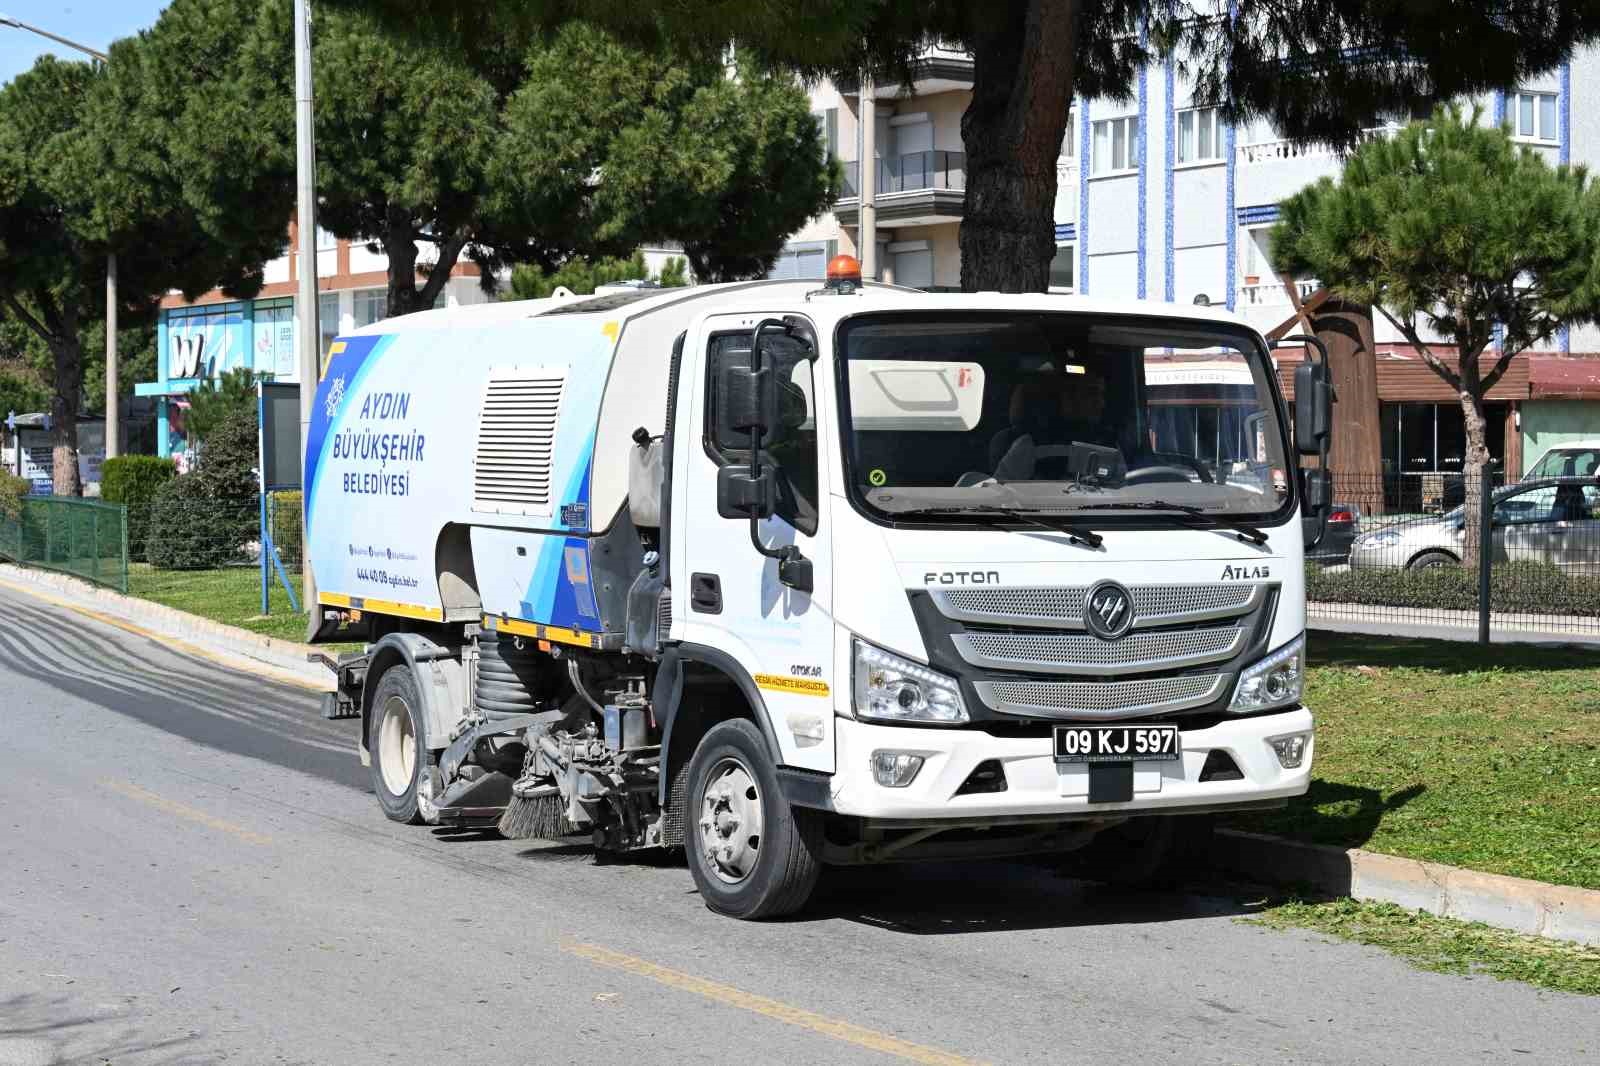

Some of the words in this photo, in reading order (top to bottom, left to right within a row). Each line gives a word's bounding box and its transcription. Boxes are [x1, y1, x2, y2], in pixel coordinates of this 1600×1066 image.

[360, 392, 411, 420] AYDIN
[333, 427, 425, 468] BÜYÜKŞEHİR
[343, 469, 410, 496] BELEDİYESİ
[357, 568, 369, 581] 444
[924, 571, 1000, 585] FOTON
[1220, 565, 1271, 581] ATLAS
[790, 664, 822, 677] OTOKAR
[1065, 730, 1093, 754] 09
[1098, 730, 1130, 754] KJ
[1135, 729, 1174, 753] 597
